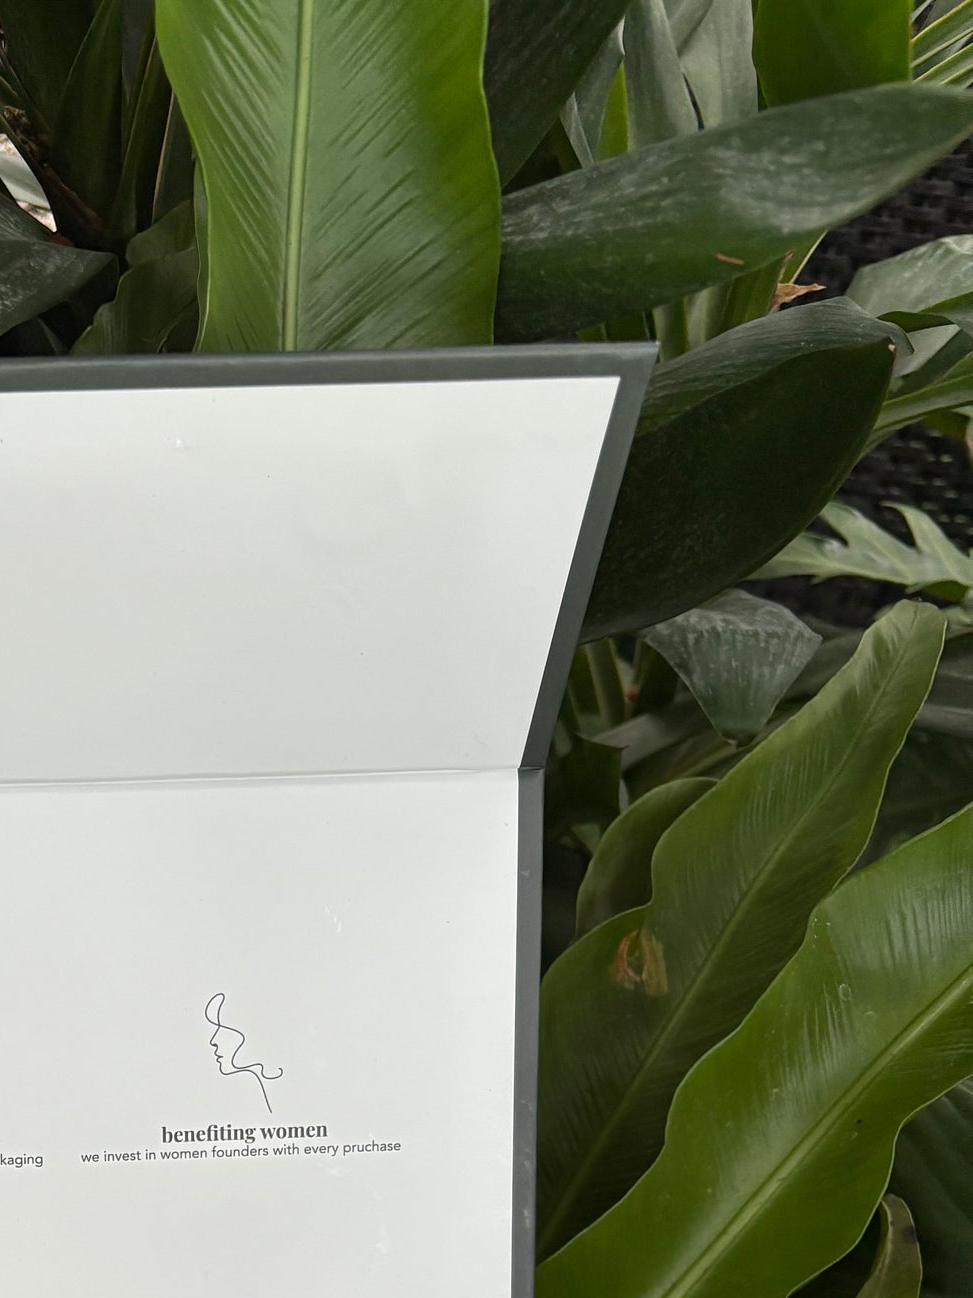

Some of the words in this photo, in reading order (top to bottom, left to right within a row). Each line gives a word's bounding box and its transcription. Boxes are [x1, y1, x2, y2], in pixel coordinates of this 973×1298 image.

[162, 1124, 256, 1144] benefiting
[261, 1125, 327, 1140] women
[81, 1153, 99, 1163] we
[104, 1150, 141, 1162] invest
[145, 1149, 156, 1160] in
[161, 1149, 207, 1160] women
[212, 1146, 269, 1159] founders
[273, 1144, 299, 1156] with
[304, 1143, 339, 1157] every
[343, 1140, 401, 1156] pruchase
